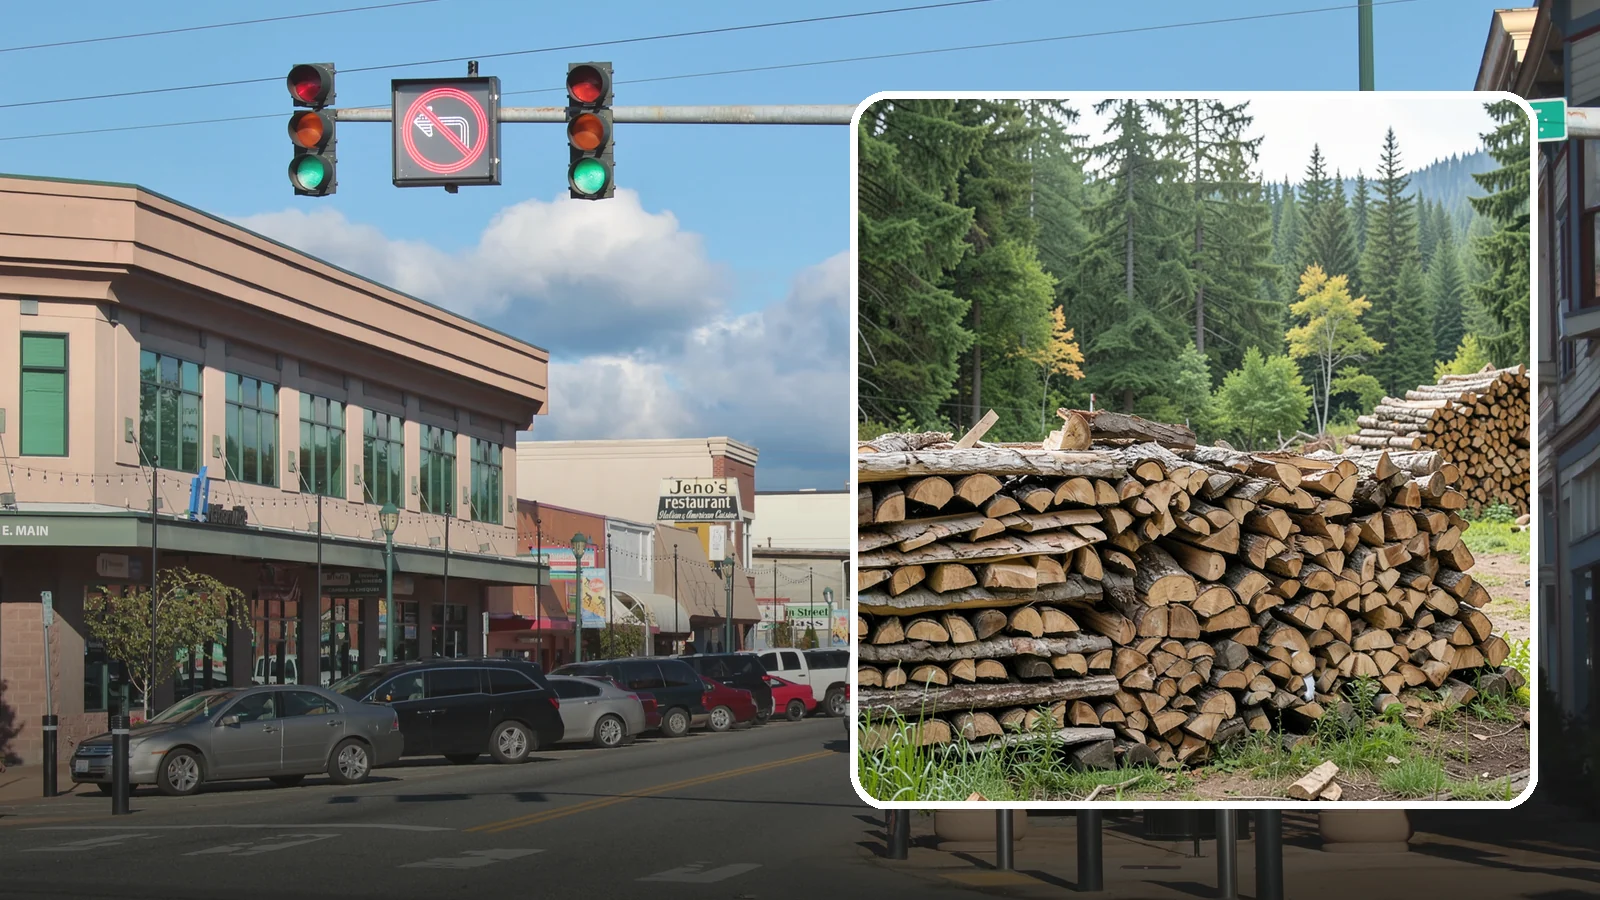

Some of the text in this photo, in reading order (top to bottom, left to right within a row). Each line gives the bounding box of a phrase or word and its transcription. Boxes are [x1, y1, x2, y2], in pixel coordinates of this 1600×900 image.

[670, 480, 728, 494] Jeno's
[665, 496, 731, 509] restaurant
[659, 510, 682, 519] Italian
[686, 510, 714, 519] American
[715, 510, 737, 519] Cuisine
[2, 525, 49, 536] E. MAIN
[797, 607, 828, 617] Street
